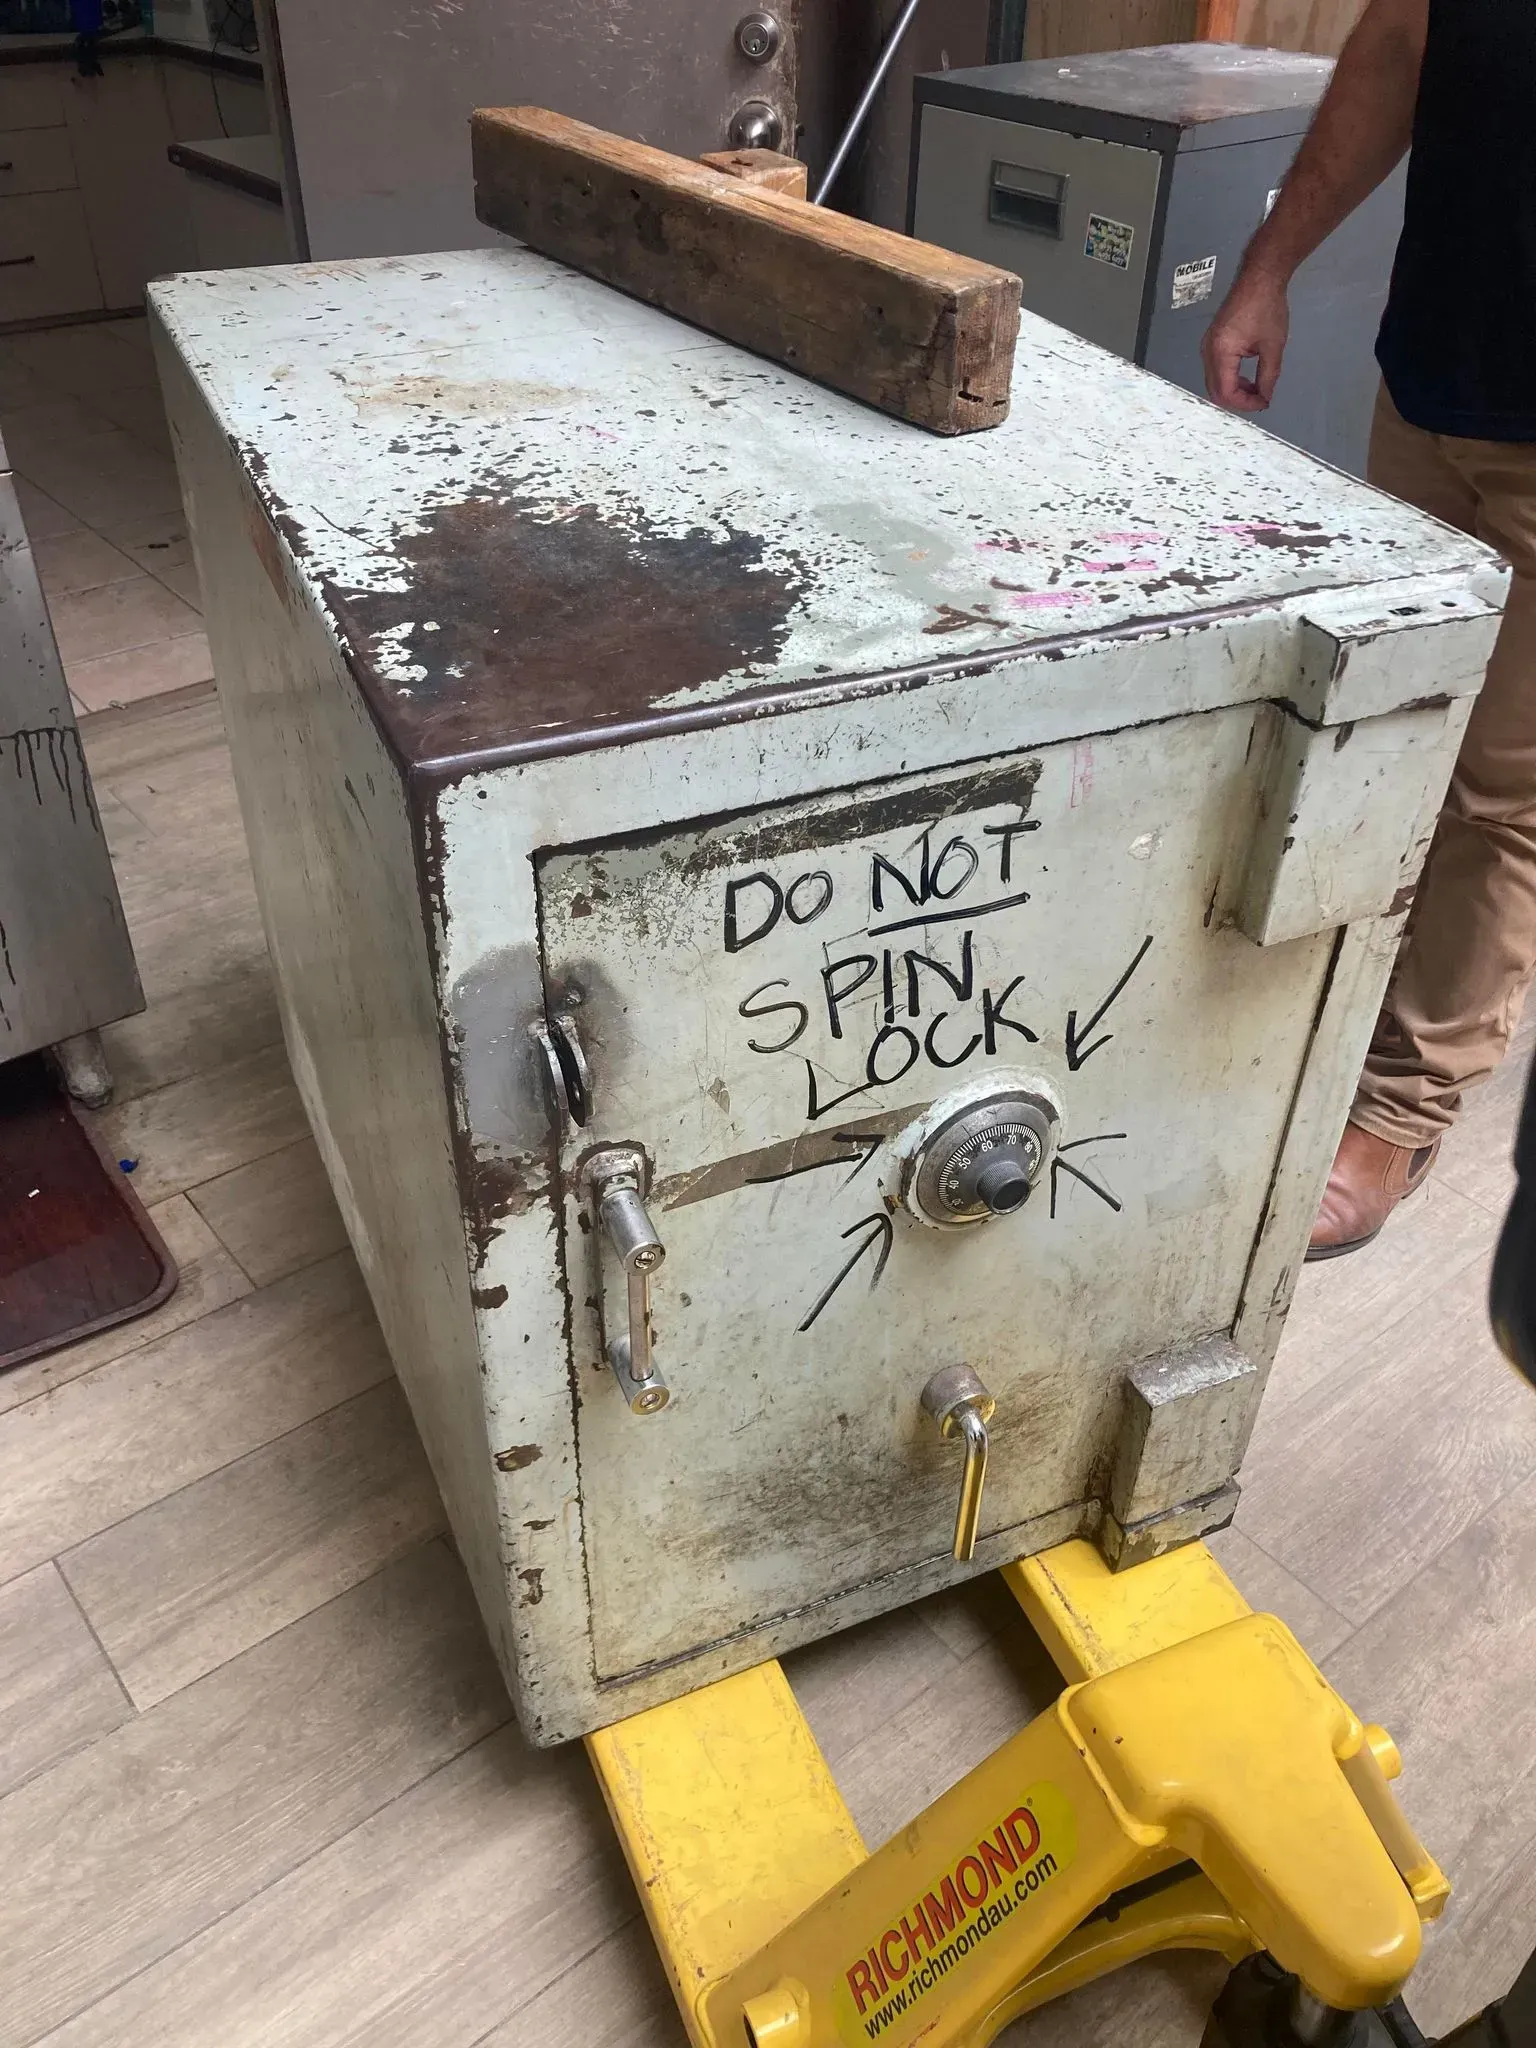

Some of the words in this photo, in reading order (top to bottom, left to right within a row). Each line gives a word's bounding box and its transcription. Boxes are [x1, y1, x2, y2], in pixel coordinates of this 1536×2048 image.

[1176, 258, 1215, 277] MOBILE
[724, 870, 834, 953] DO
[870, 820, 1042, 913] NOT
[738, 930, 973, 1053] SPIN
[806, 976, 1039, 1120] LOCK
[948, 1179, 960, 1190] 40
[958, 1156, 972, 1170] 50
[981, 1139, 993, 1153] 60
[1006, 1134, 1017, 1146] 70
[1024, 1141, 1033, 1154] 80
[864, 1852, 1058, 2040] www.richmondau.com
